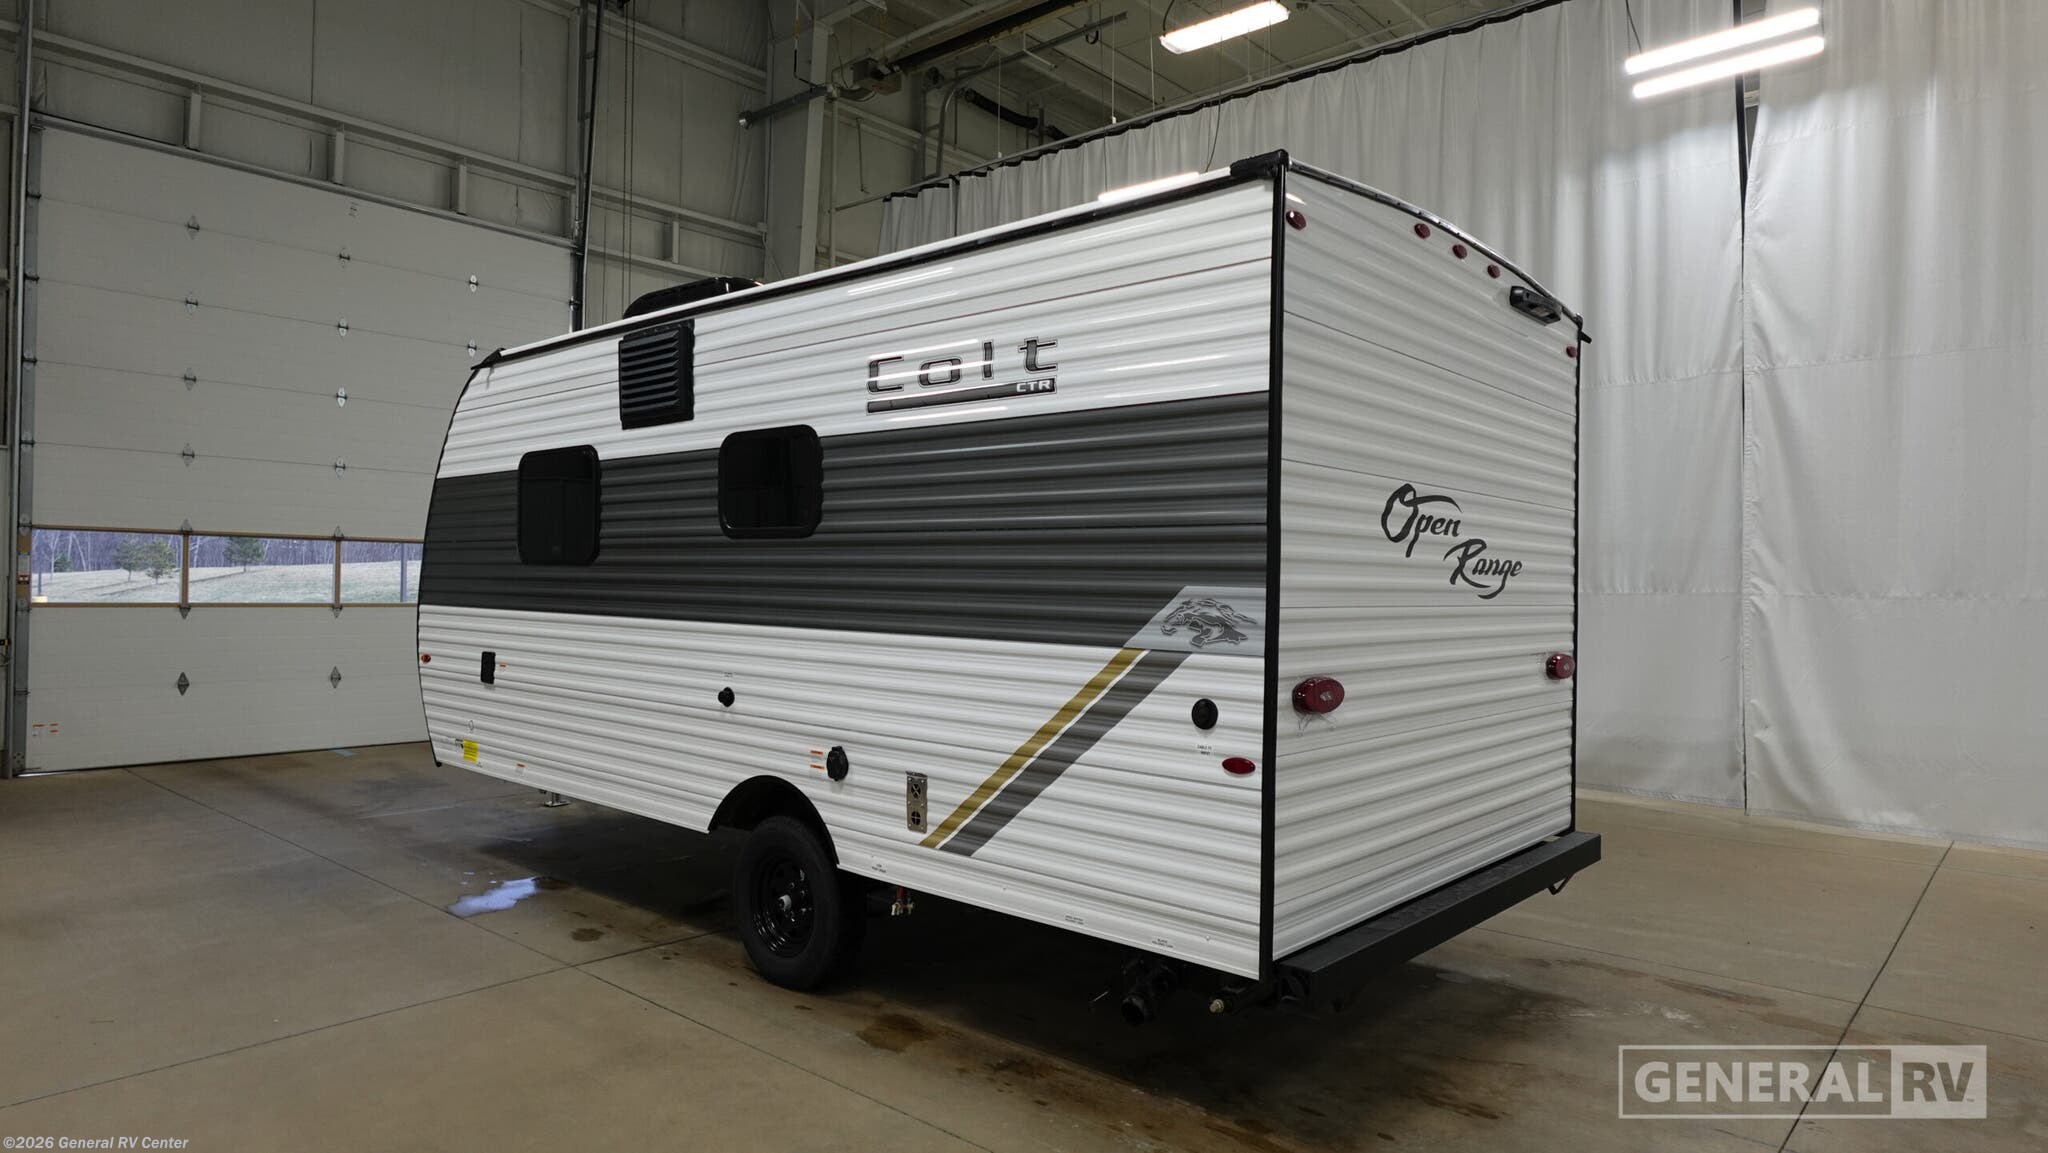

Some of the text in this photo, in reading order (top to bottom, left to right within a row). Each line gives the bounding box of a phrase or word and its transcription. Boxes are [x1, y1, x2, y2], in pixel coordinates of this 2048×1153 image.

[867, 337, 1057, 394] Colt
[1016, 379, 1051, 393] CTR
[1381, 483, 1463, 558] Open
[1443, 538, 1523, 600] Range
